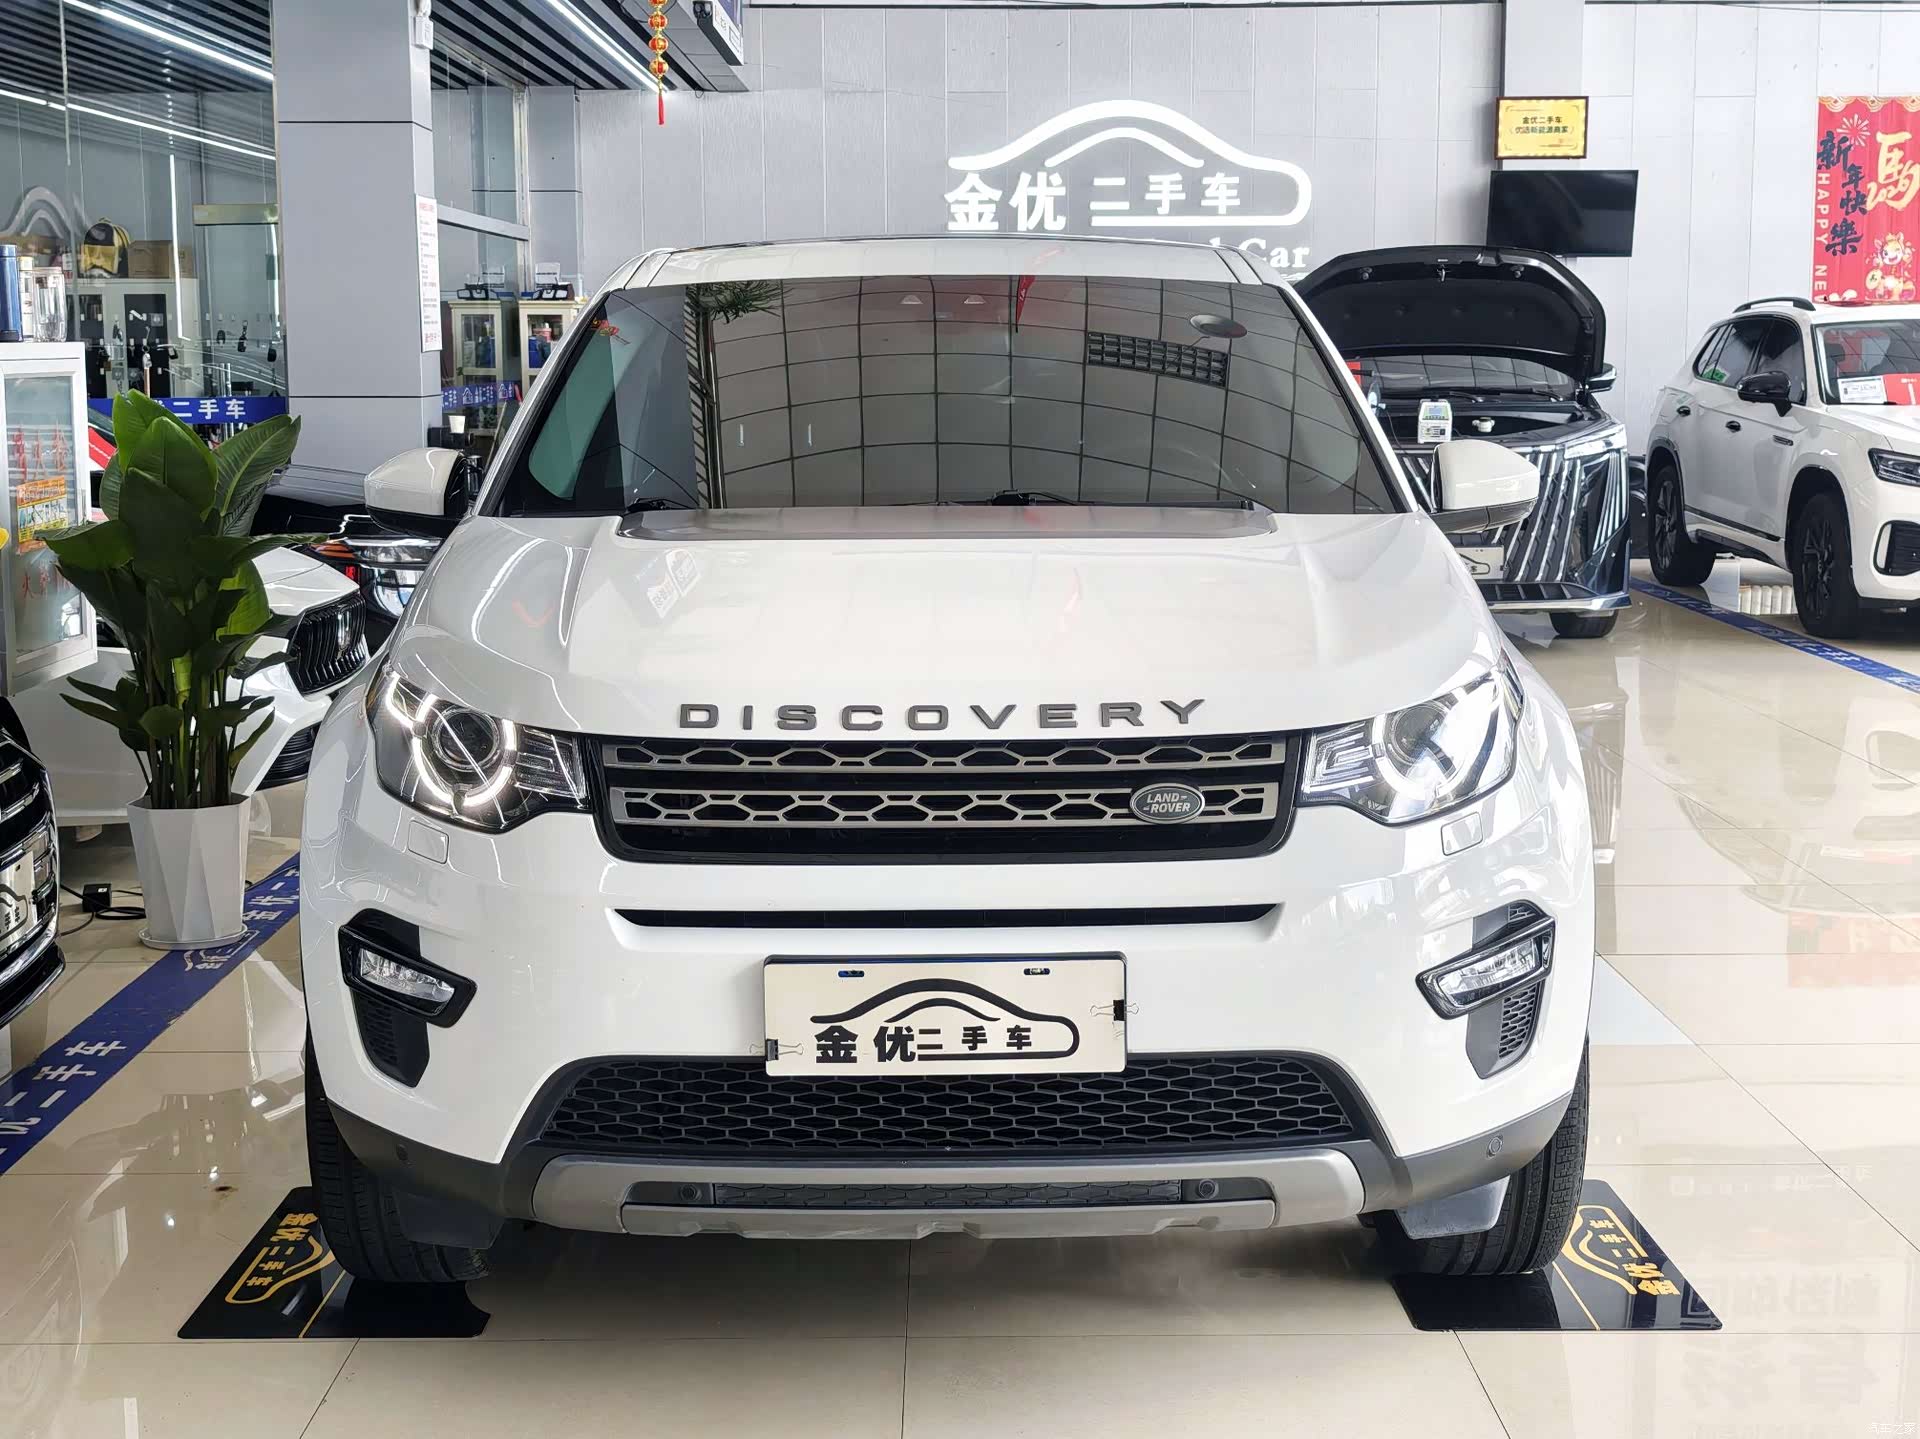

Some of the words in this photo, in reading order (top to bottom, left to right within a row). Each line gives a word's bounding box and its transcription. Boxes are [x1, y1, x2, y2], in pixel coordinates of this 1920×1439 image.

[944, 172, 1241, 231] 金优二手车
[1816, 173, 1831, 245] HAPPY
[1817, 130, 1868, 256] 新年快樂
[153, 399, 247, 420] 二手车
[679, 699, 1206, 731] DISCOVERY
[815, 1025, 1033, 1064] 金优二手车
